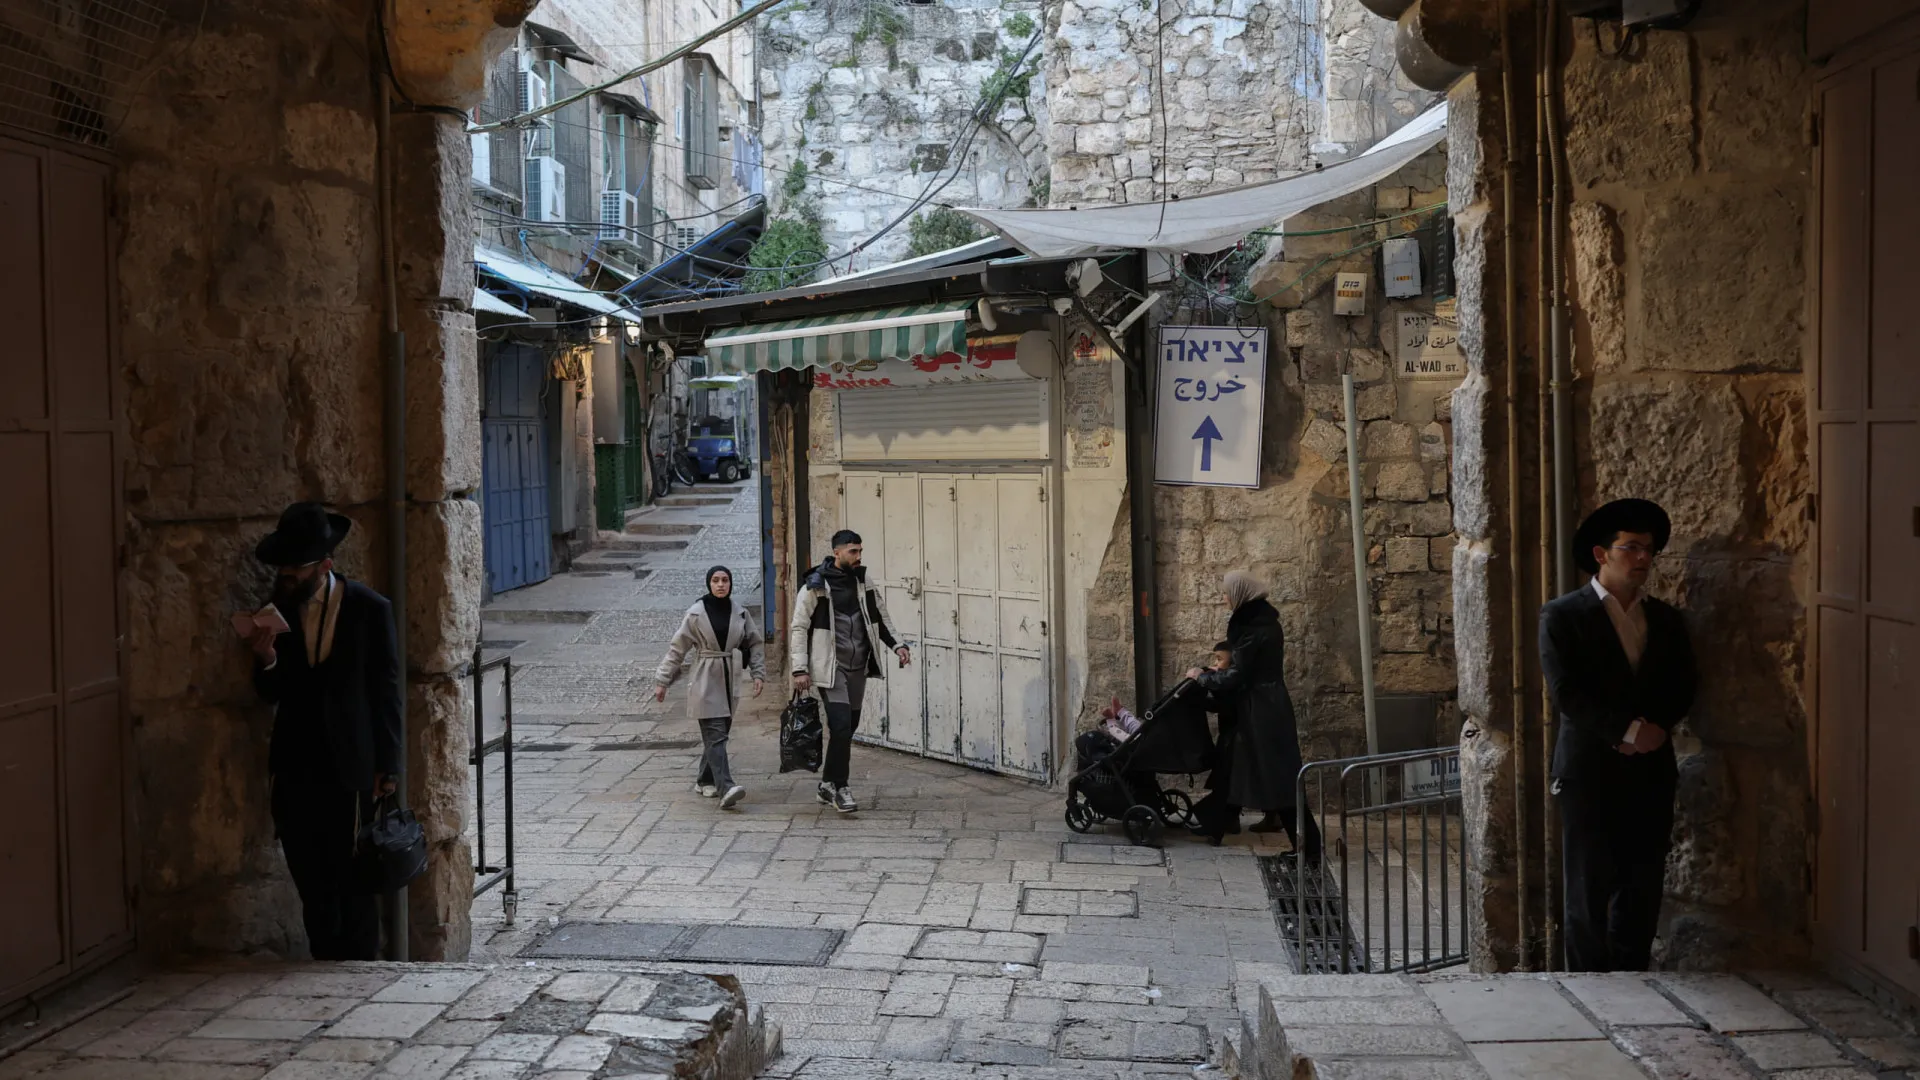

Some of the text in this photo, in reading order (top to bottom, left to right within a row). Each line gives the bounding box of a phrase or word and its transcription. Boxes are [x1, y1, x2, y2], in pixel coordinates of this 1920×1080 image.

[1407, 334, 1456, 349] طريق الواد
[1166, 340, 1259, 363] יציאה
[1405, 361, 1460, 373] AL-WAD ST.
[1174, 374, 1247, 401] خروج
